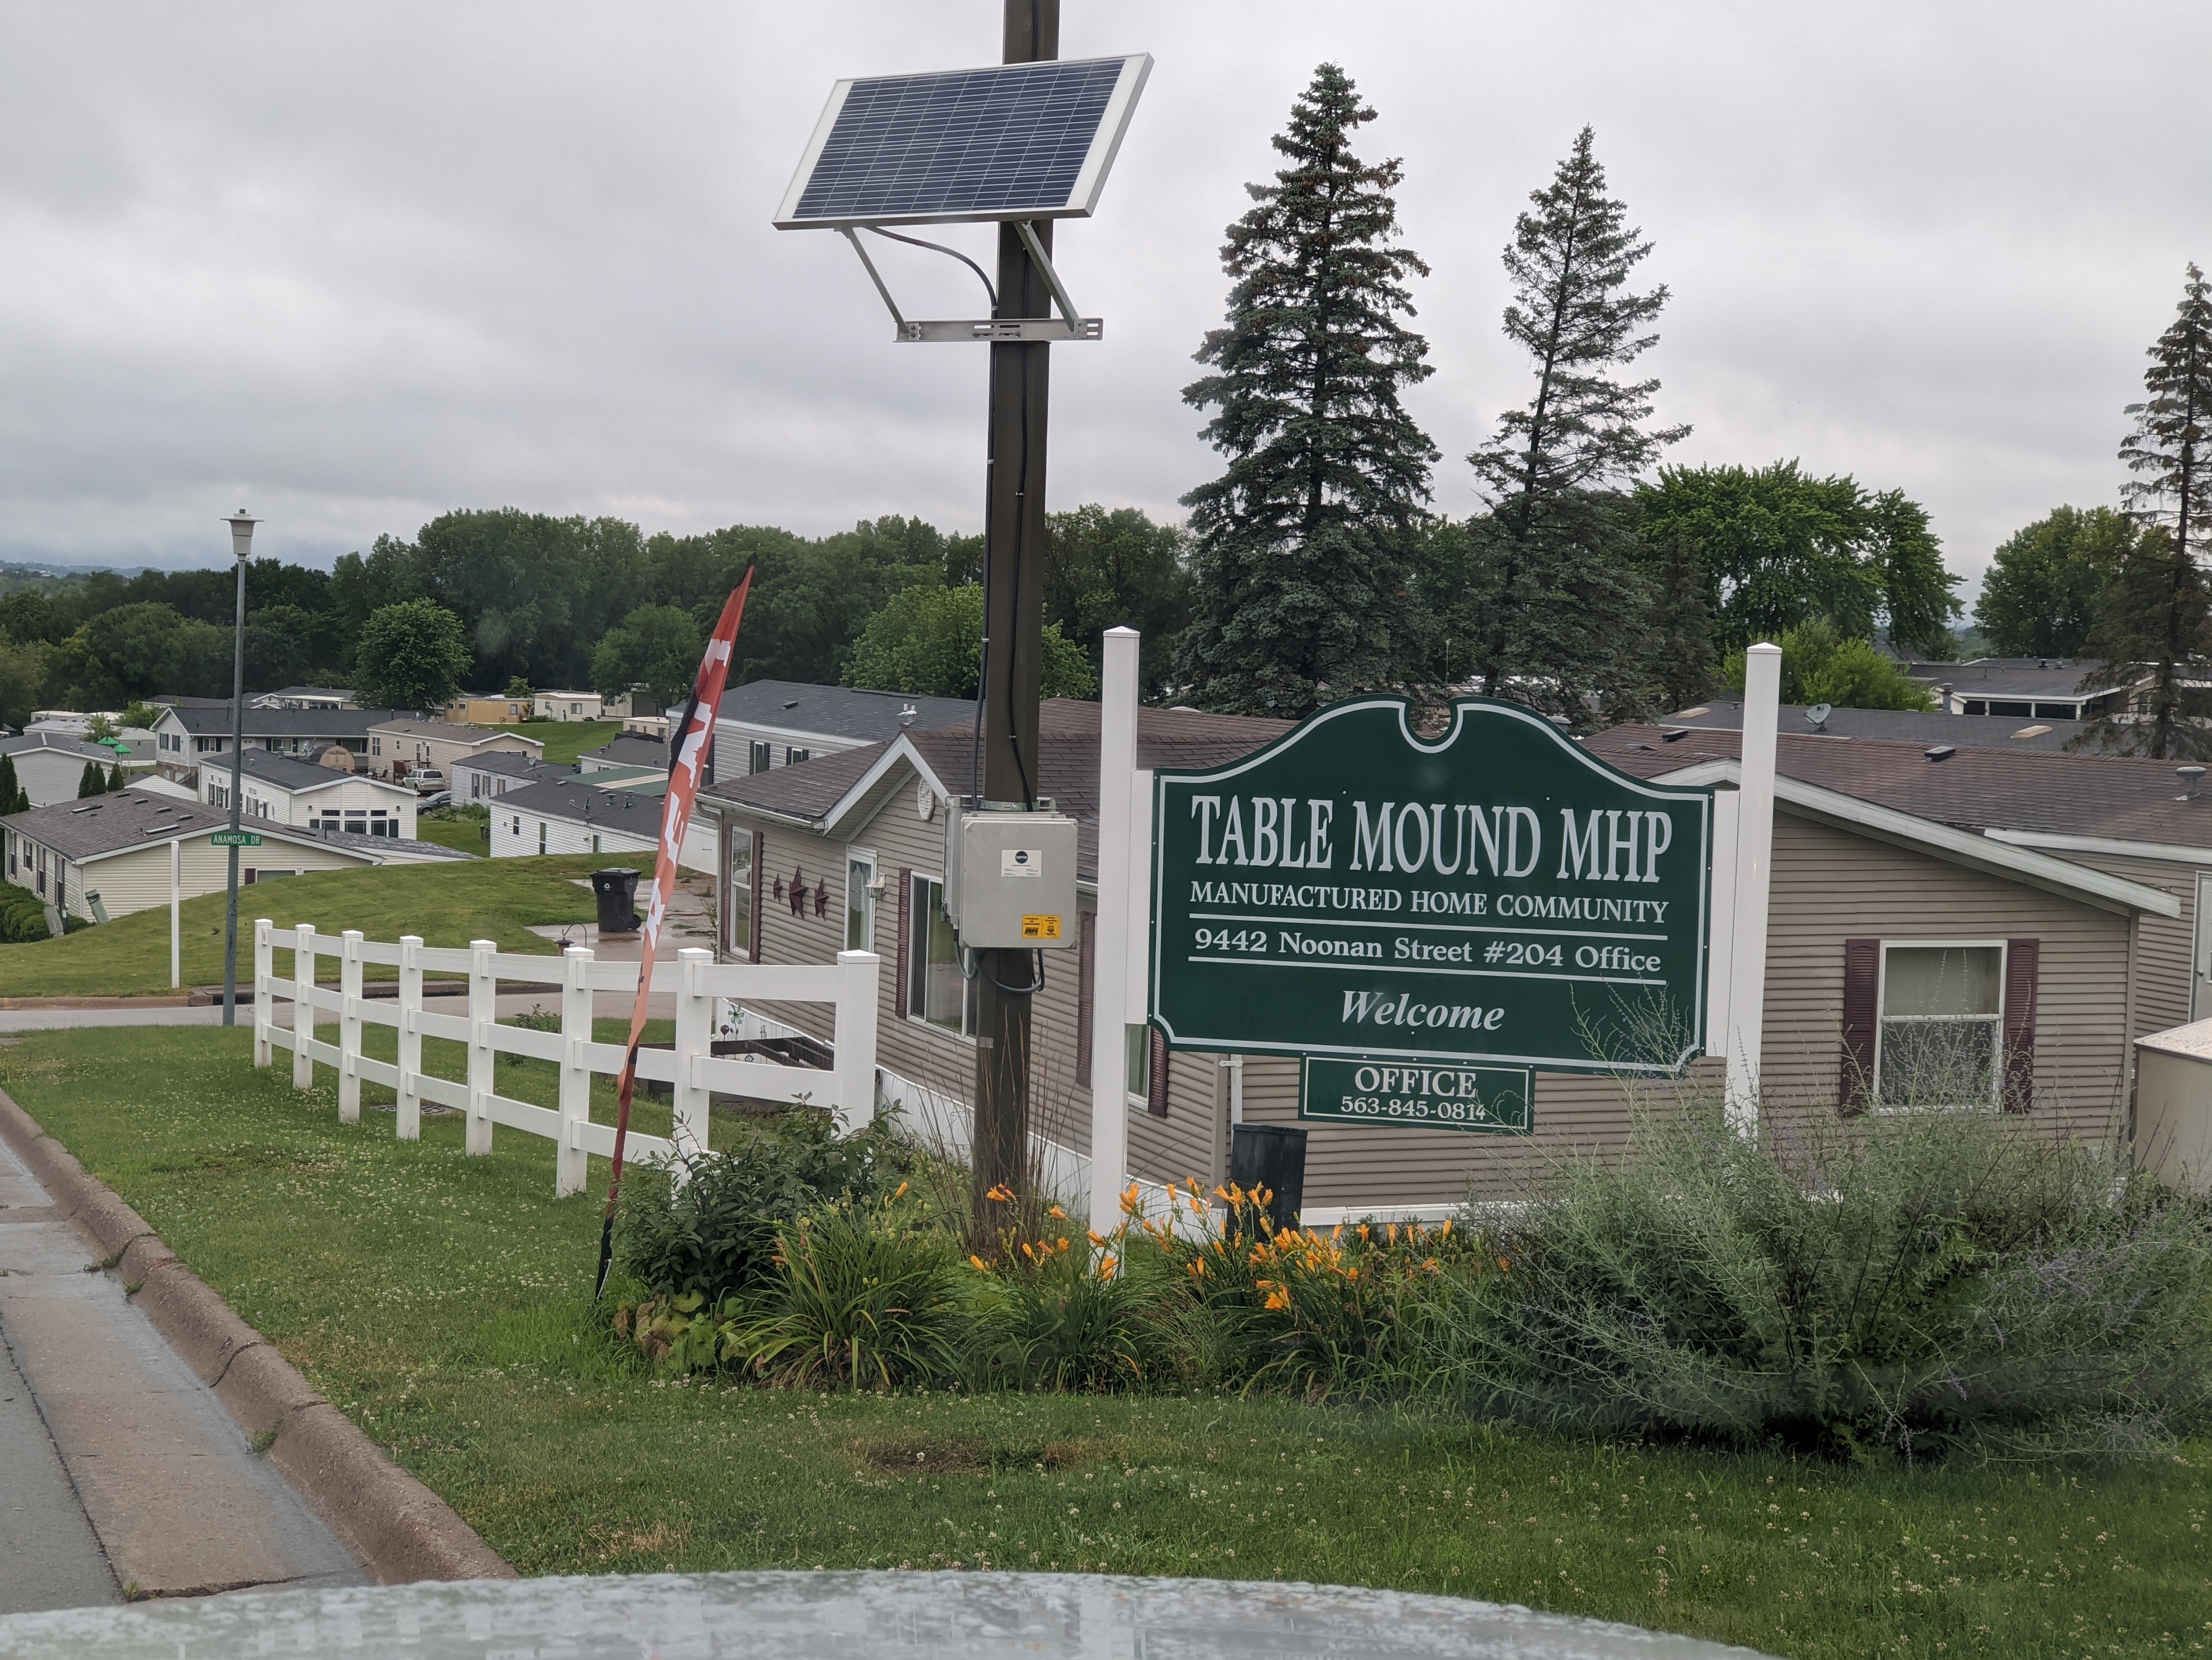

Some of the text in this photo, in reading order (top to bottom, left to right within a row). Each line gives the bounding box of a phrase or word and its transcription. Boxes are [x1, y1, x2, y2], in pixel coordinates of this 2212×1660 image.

[213, 834, 260, 844] ANAMOSA DR
[1191, 794, 1672, 883] TABLE MOUND MHP
[1189, 881, 1669, 923] MANUFACTURED HOME COMMUNITY
[1195, 928, 1661, 972] 9442 Noonan Street #204 Office
[1342, 990, 1505, 1031] Welcome
[1355, 1067, 1476, 1098] OFFICE
[1340, 1096, 1486, 1121] 563-845-0814
